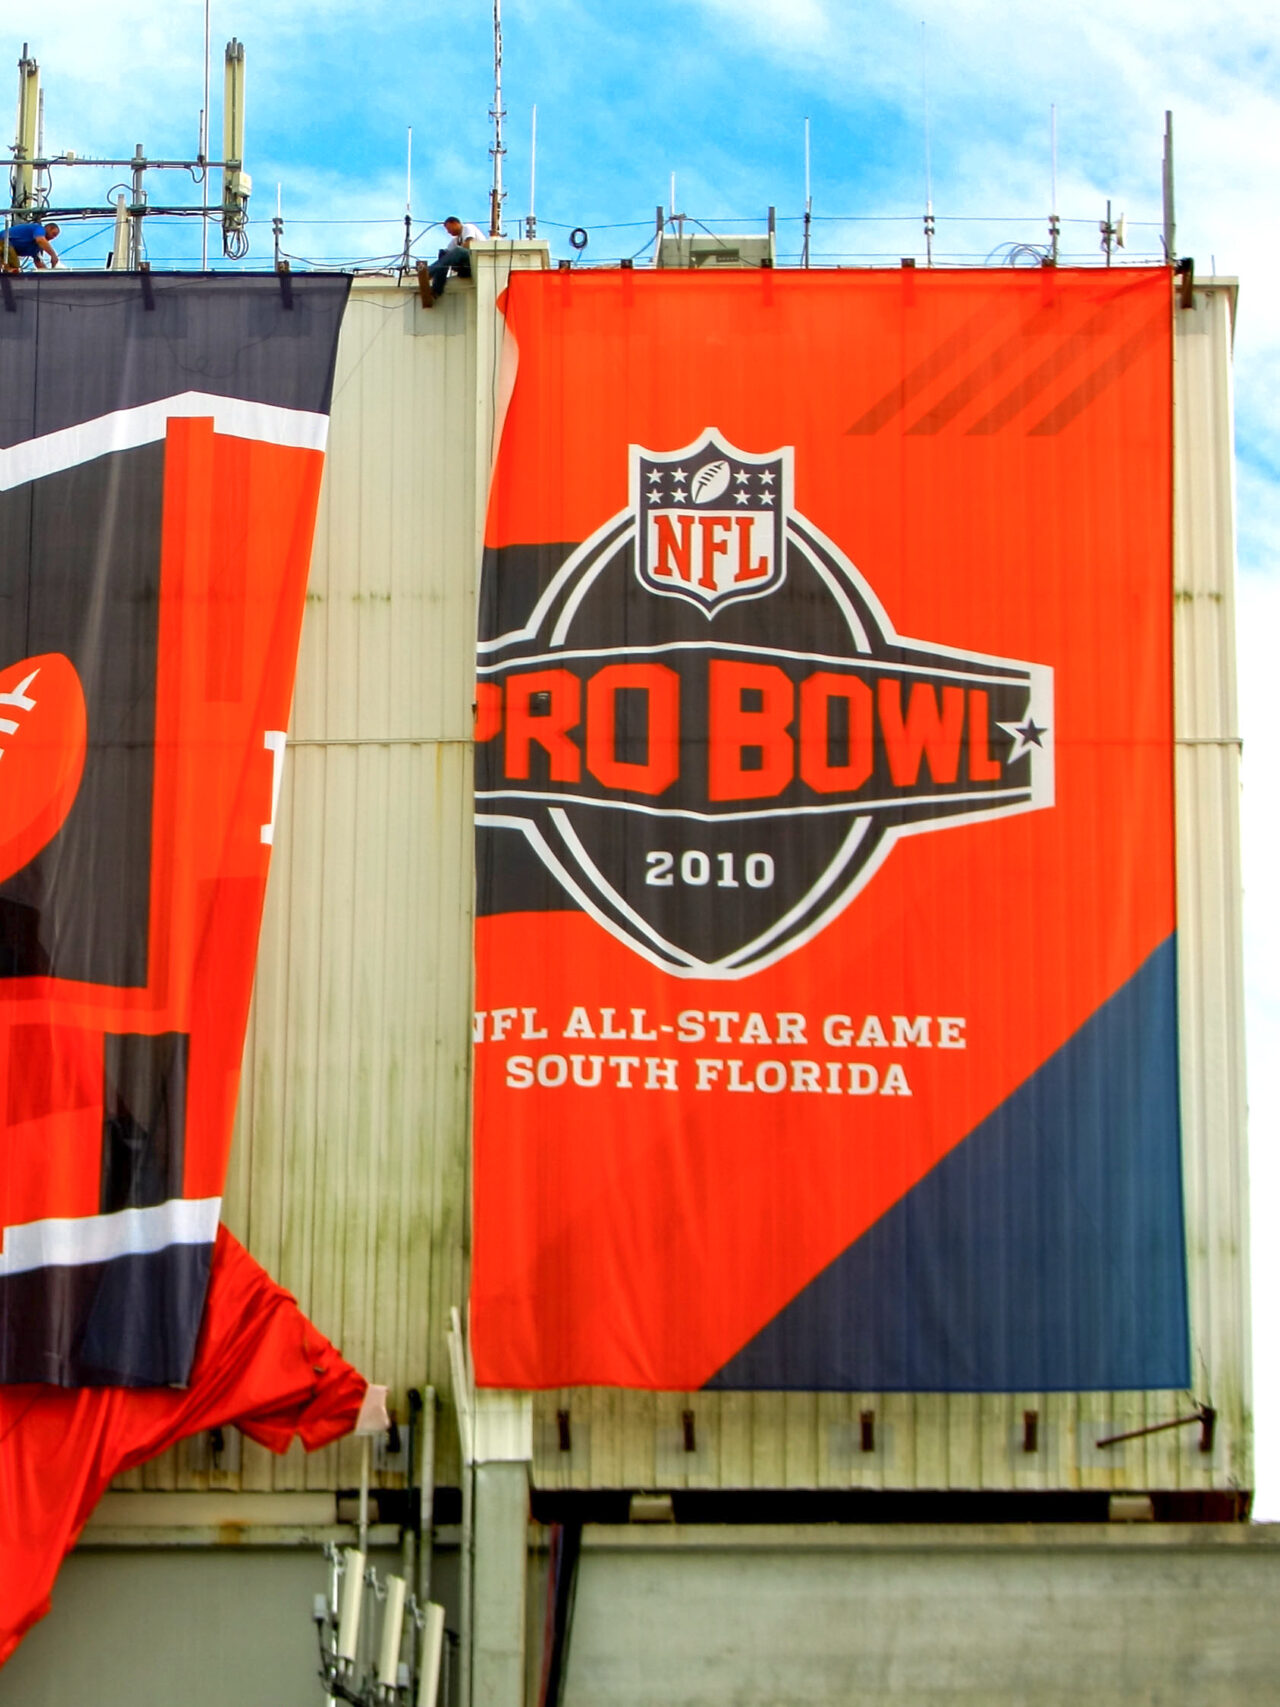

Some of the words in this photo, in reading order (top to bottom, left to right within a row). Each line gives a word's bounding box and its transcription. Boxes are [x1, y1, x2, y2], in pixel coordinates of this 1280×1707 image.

[653, 514, 768, 592] NFL
[708, 658, 1001, 801] BOWL
[645, 851, 774, 888] 2010
[563, 1007, 808, 1045] ALL-STAR
[823, 1015, 967, 1049] GAME
[505, 1055, 679, 1091] SOUTH
[695, 1058, 913, 1096] FLORIDA
